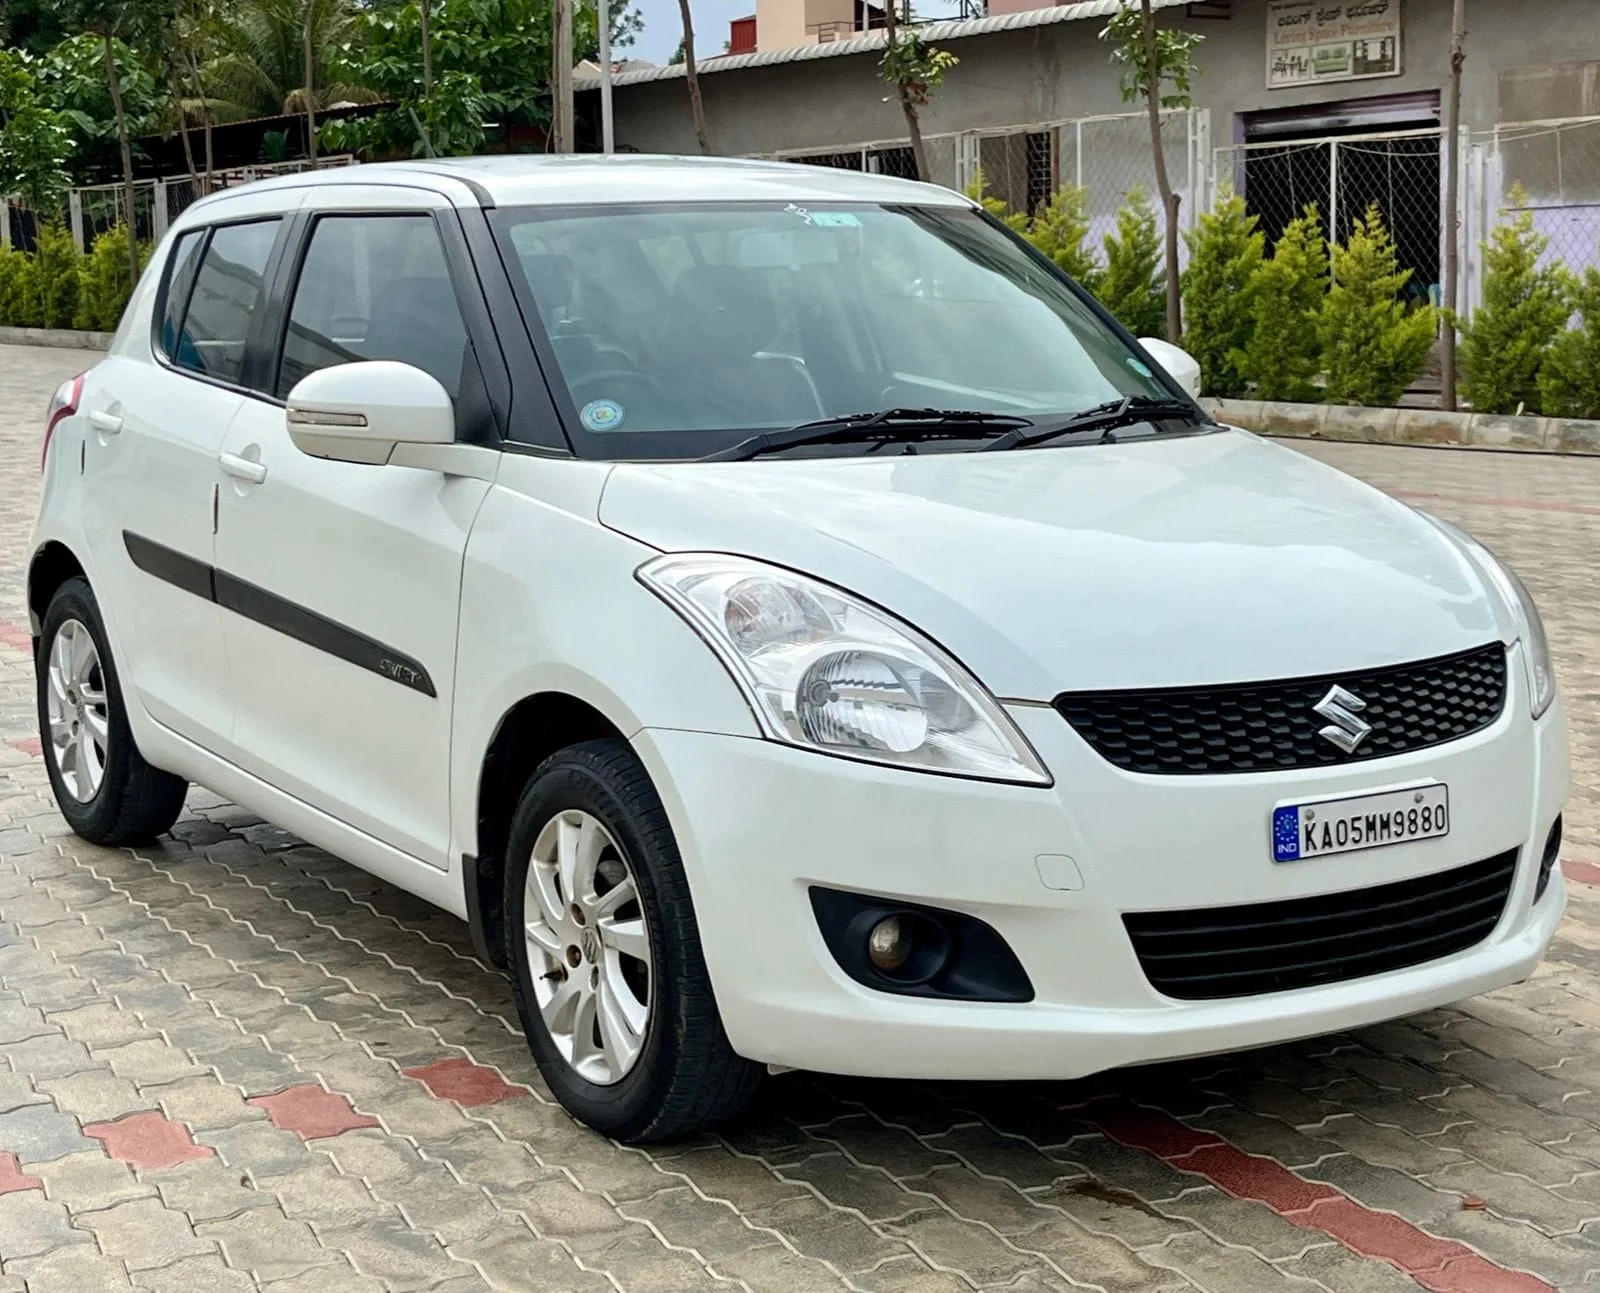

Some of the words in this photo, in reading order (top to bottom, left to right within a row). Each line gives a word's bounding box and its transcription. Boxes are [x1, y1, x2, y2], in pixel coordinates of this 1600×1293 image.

[1341, 22, 1394, 36] Furniture
[1304, 804, 1445, 851] KA05MM9880
[1277, 843, 1297, 854] IND
